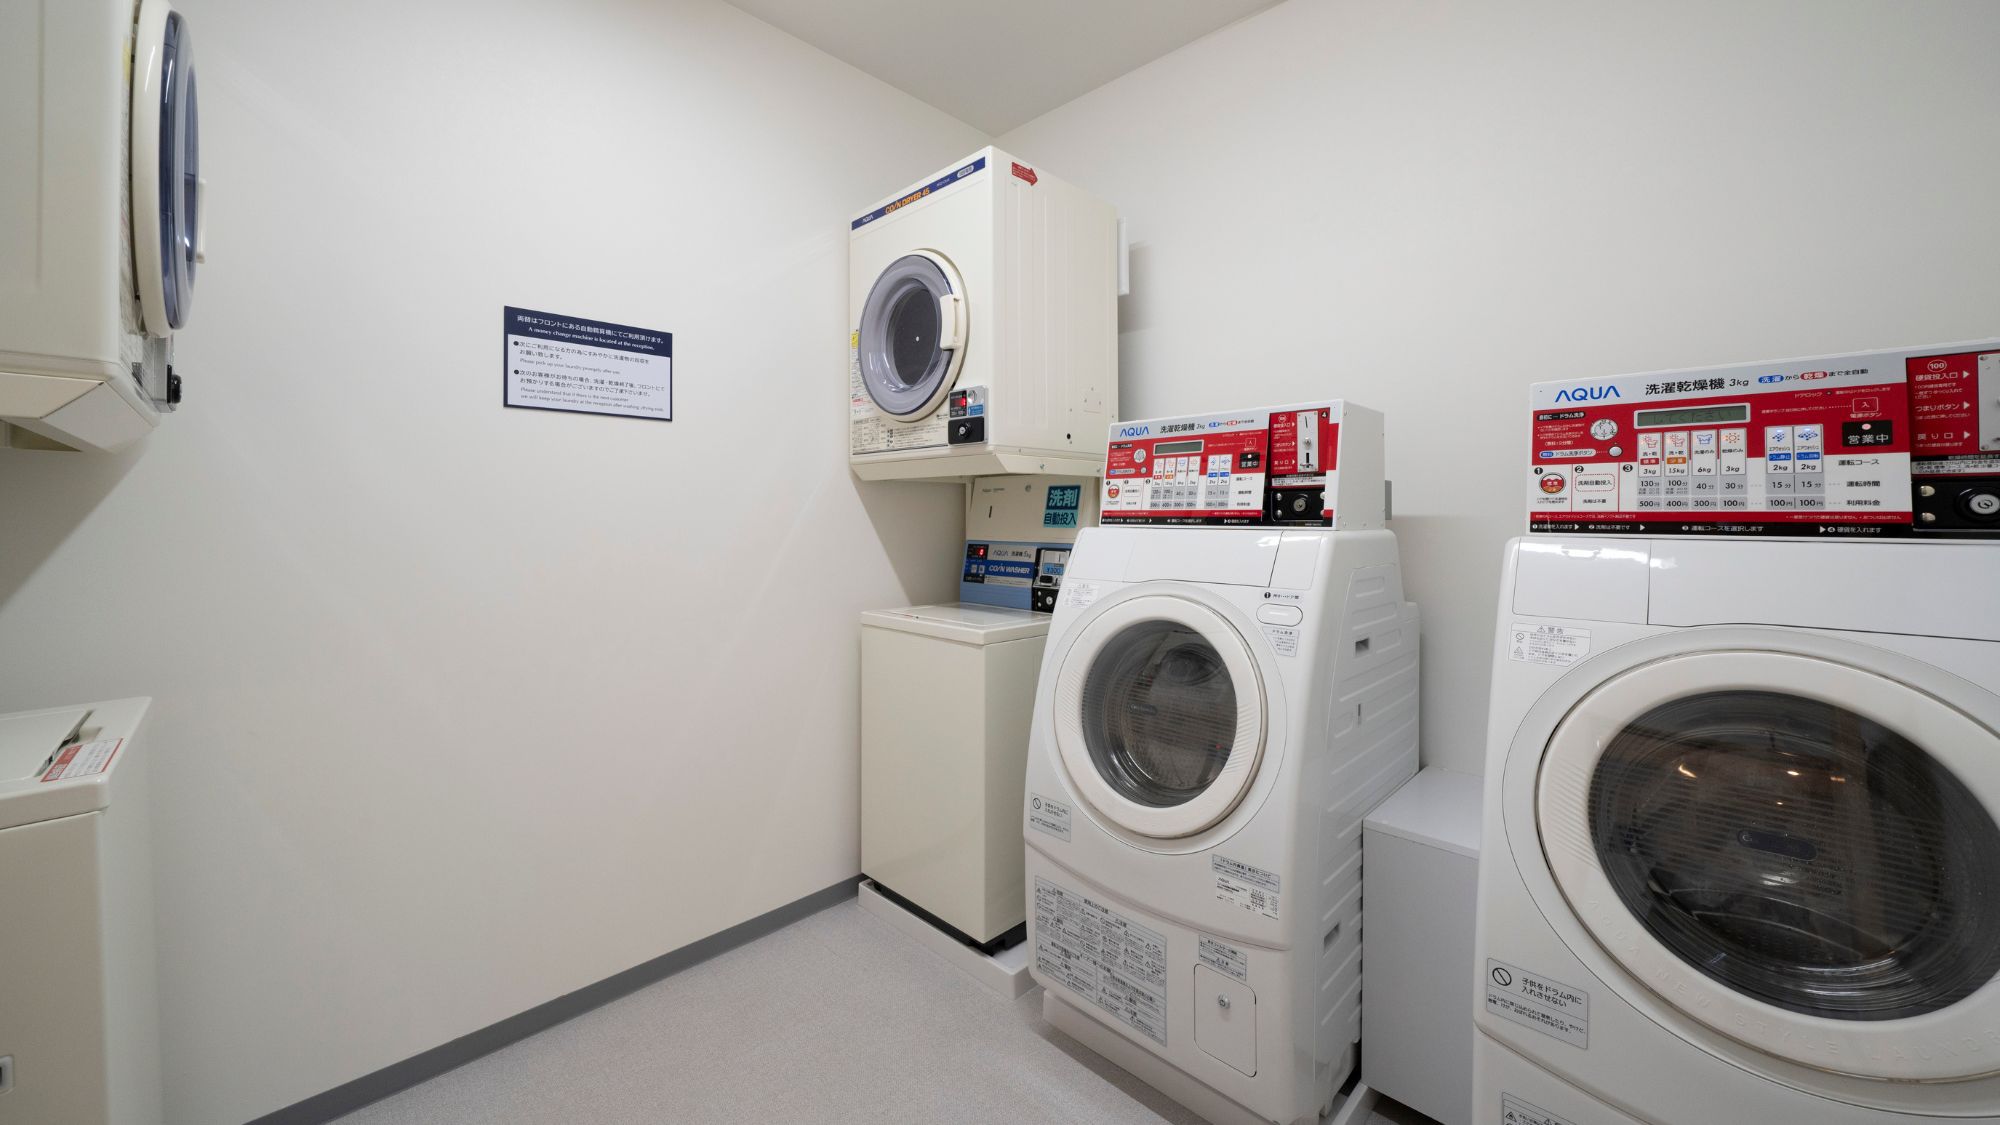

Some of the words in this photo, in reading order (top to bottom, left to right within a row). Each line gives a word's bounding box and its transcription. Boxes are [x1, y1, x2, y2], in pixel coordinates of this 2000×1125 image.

[902, 192, 922, 206] DRYER
[552, 330, 571, 338] change
[600, 337, 616, 345] located
[1915, 372, 1958, 381] 硬貨投入口
[1555, 385, 1620, 402] AQUA
[1646, 378, 1725, 395] 洗濯乾燥機
[1729, 378, 1749, 387] 3kg
[1915, 403, 1960, 412] つまりボタン
[1120, 426, 1149, 437] AQUA
[1160, 423, 1195, 434] 洗濯乾燥機
[1848, 434, 1889, 444] 営業中
[1049, 488, 1078, 507] 洗剤
[1044, 512, 1077, 525] 自動投入
[1521, 977, 1582, 1005] 子供をドラム内に
[1522, 986, 1567, 1007] 入れさせない
